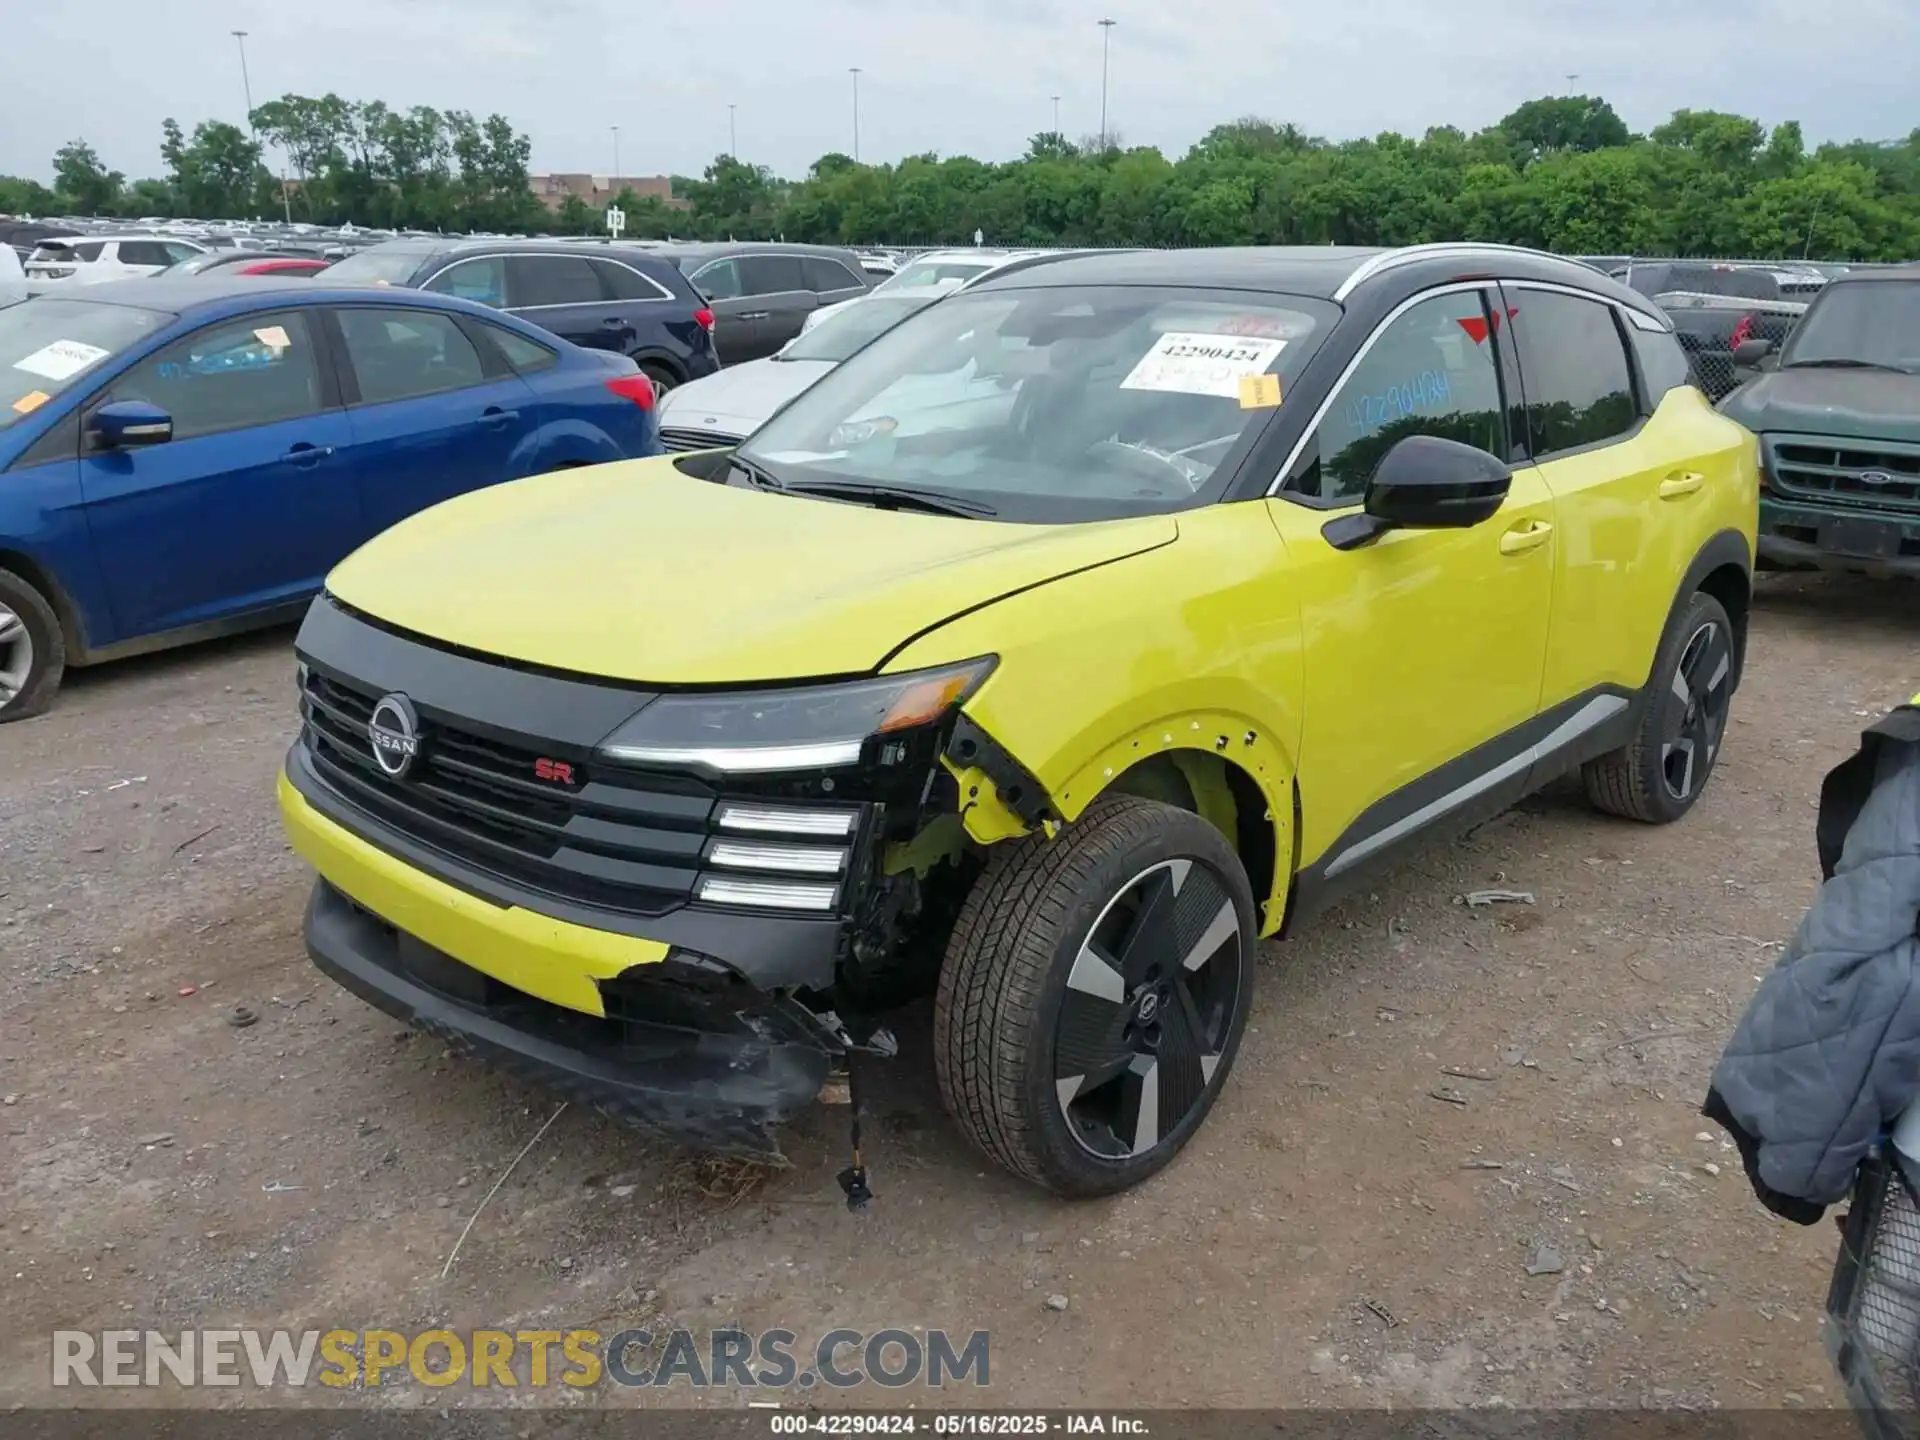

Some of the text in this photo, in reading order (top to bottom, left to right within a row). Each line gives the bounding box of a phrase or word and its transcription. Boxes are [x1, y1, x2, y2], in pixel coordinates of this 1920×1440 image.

[1161, 344, 1261, 362] 42290424
[374, 731, 416, 754] SSAN
[534, 756, 575, 785] SR
